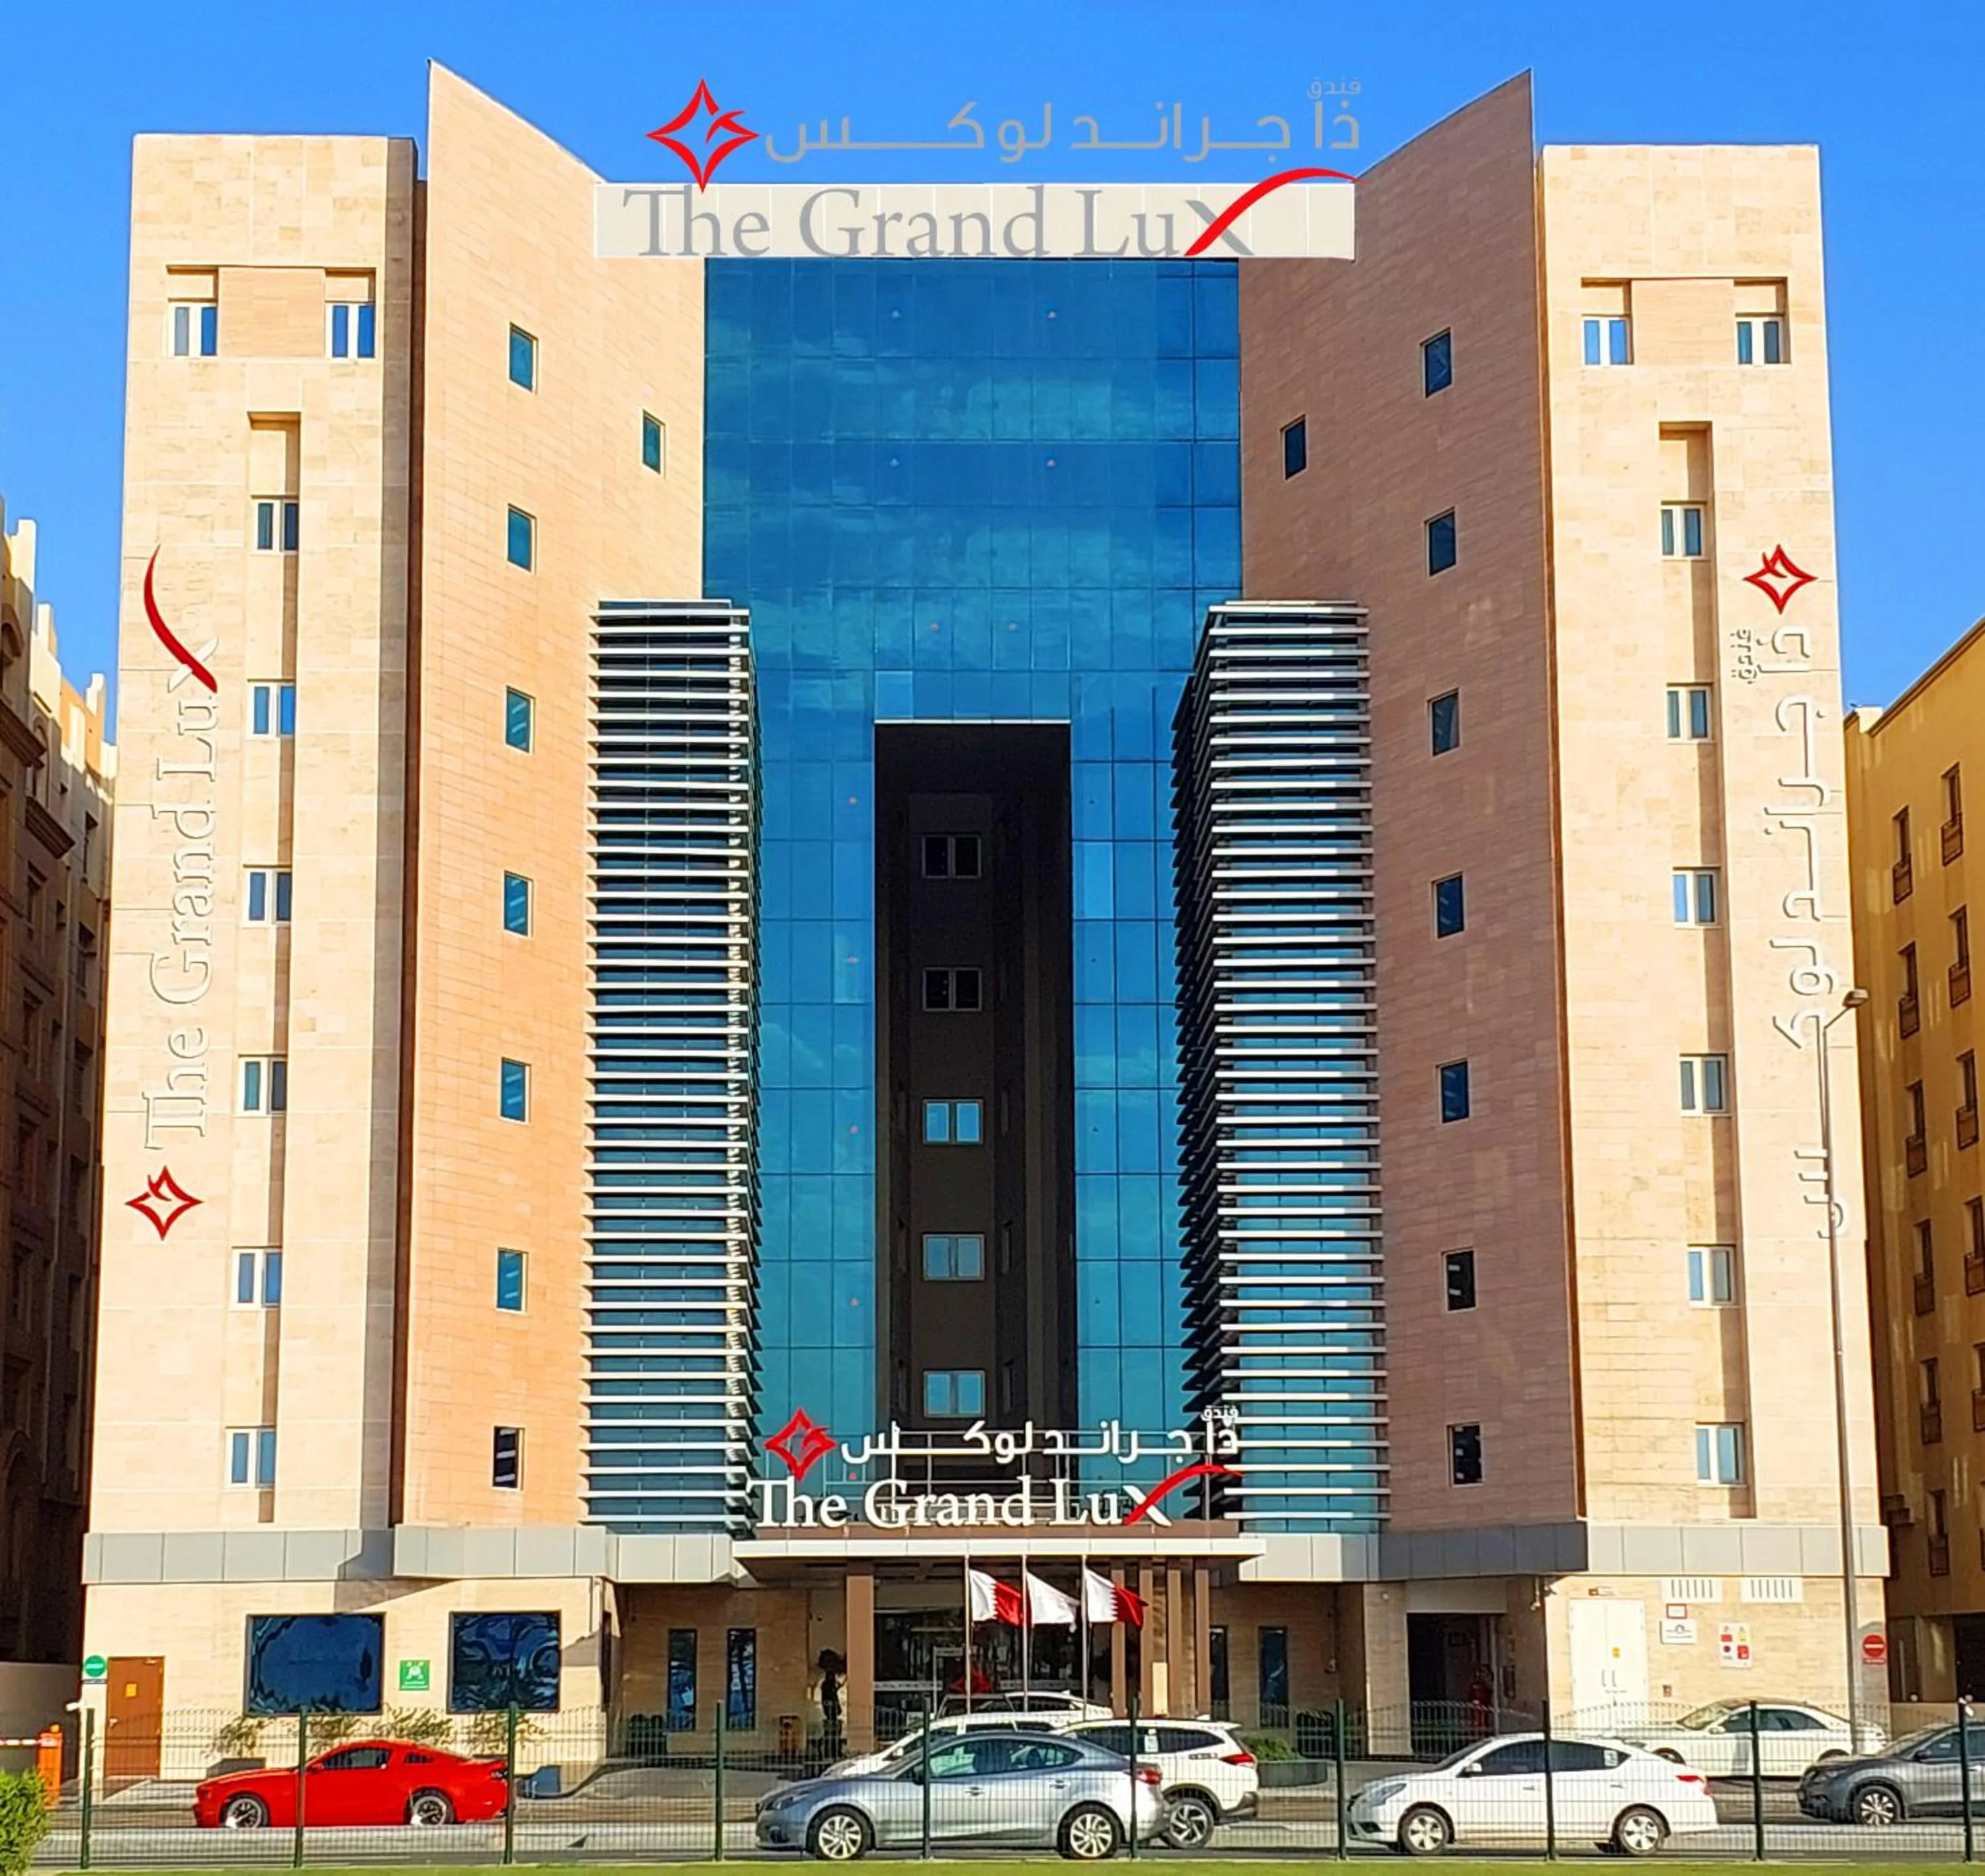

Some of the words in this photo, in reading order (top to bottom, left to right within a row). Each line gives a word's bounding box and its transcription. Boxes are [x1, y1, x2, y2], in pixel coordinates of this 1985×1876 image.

[1307, 76, 1361, 100] فندق
[764, 101, 1051, 163] لوكس
[1071, 101, 1290, 163] جراند
[1315, 100, 1359, 149] ذا
[622, 186, 770, 257] The
[799, 185, 1045, 257] Grand
[1730, 628, 1757, 684] فندق
[149, 800, 216, 1005] Grand
[142, 1028, 209, 1150] The
[1200, 1405, 1239, 1421] فندق
[1206, 1418, 1239, 1454] ذا
[842, 1420, 1033, 1464] لوكس
[1043, 1420, 1192, 1464] جراند
[747, 1476, 848, 1528] The
[865, 1474, 1036, 1529] Grand
